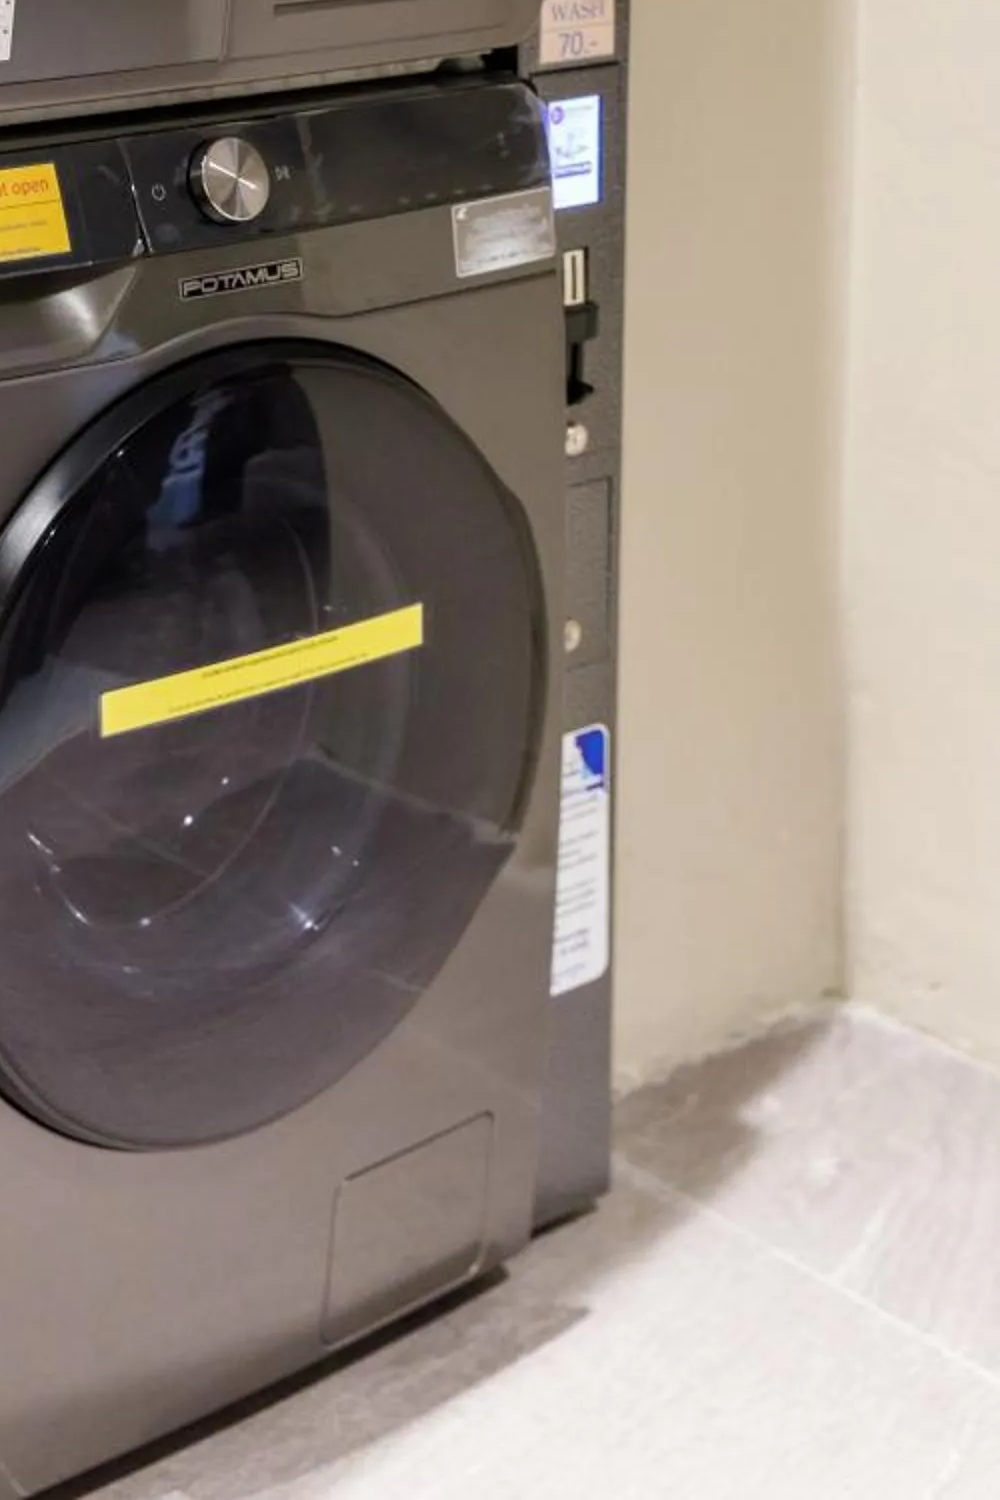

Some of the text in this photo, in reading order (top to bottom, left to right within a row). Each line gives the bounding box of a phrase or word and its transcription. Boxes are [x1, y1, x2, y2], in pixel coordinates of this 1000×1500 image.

[552, 1, 606, 22] WASH
[11, 176, 49, 197] open
[182, 260, 300, 297] POTAMUS
